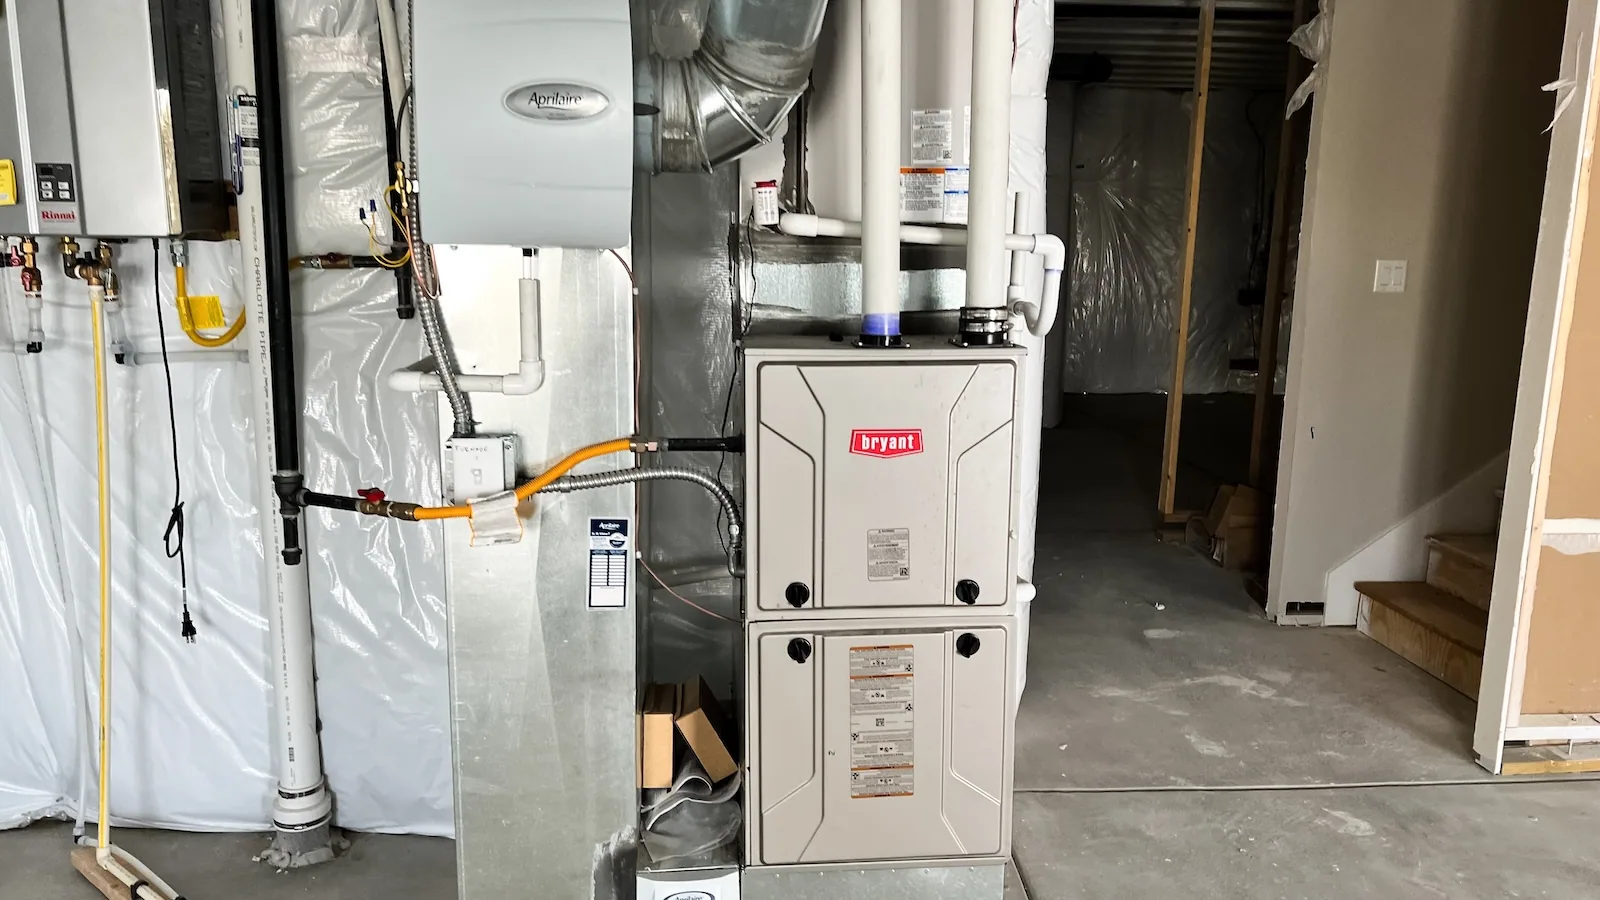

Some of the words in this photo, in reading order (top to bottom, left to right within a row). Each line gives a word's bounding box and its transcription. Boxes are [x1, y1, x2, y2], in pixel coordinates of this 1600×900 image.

[528, 91, 582, 109] Aprilaire
[41, 210, 76, 220] Rinnai
[254, 257, 264, 324] CHARLOTTE
[260, 330, 268, 361] PIPE
[861, 434, 914, 452] bryant
